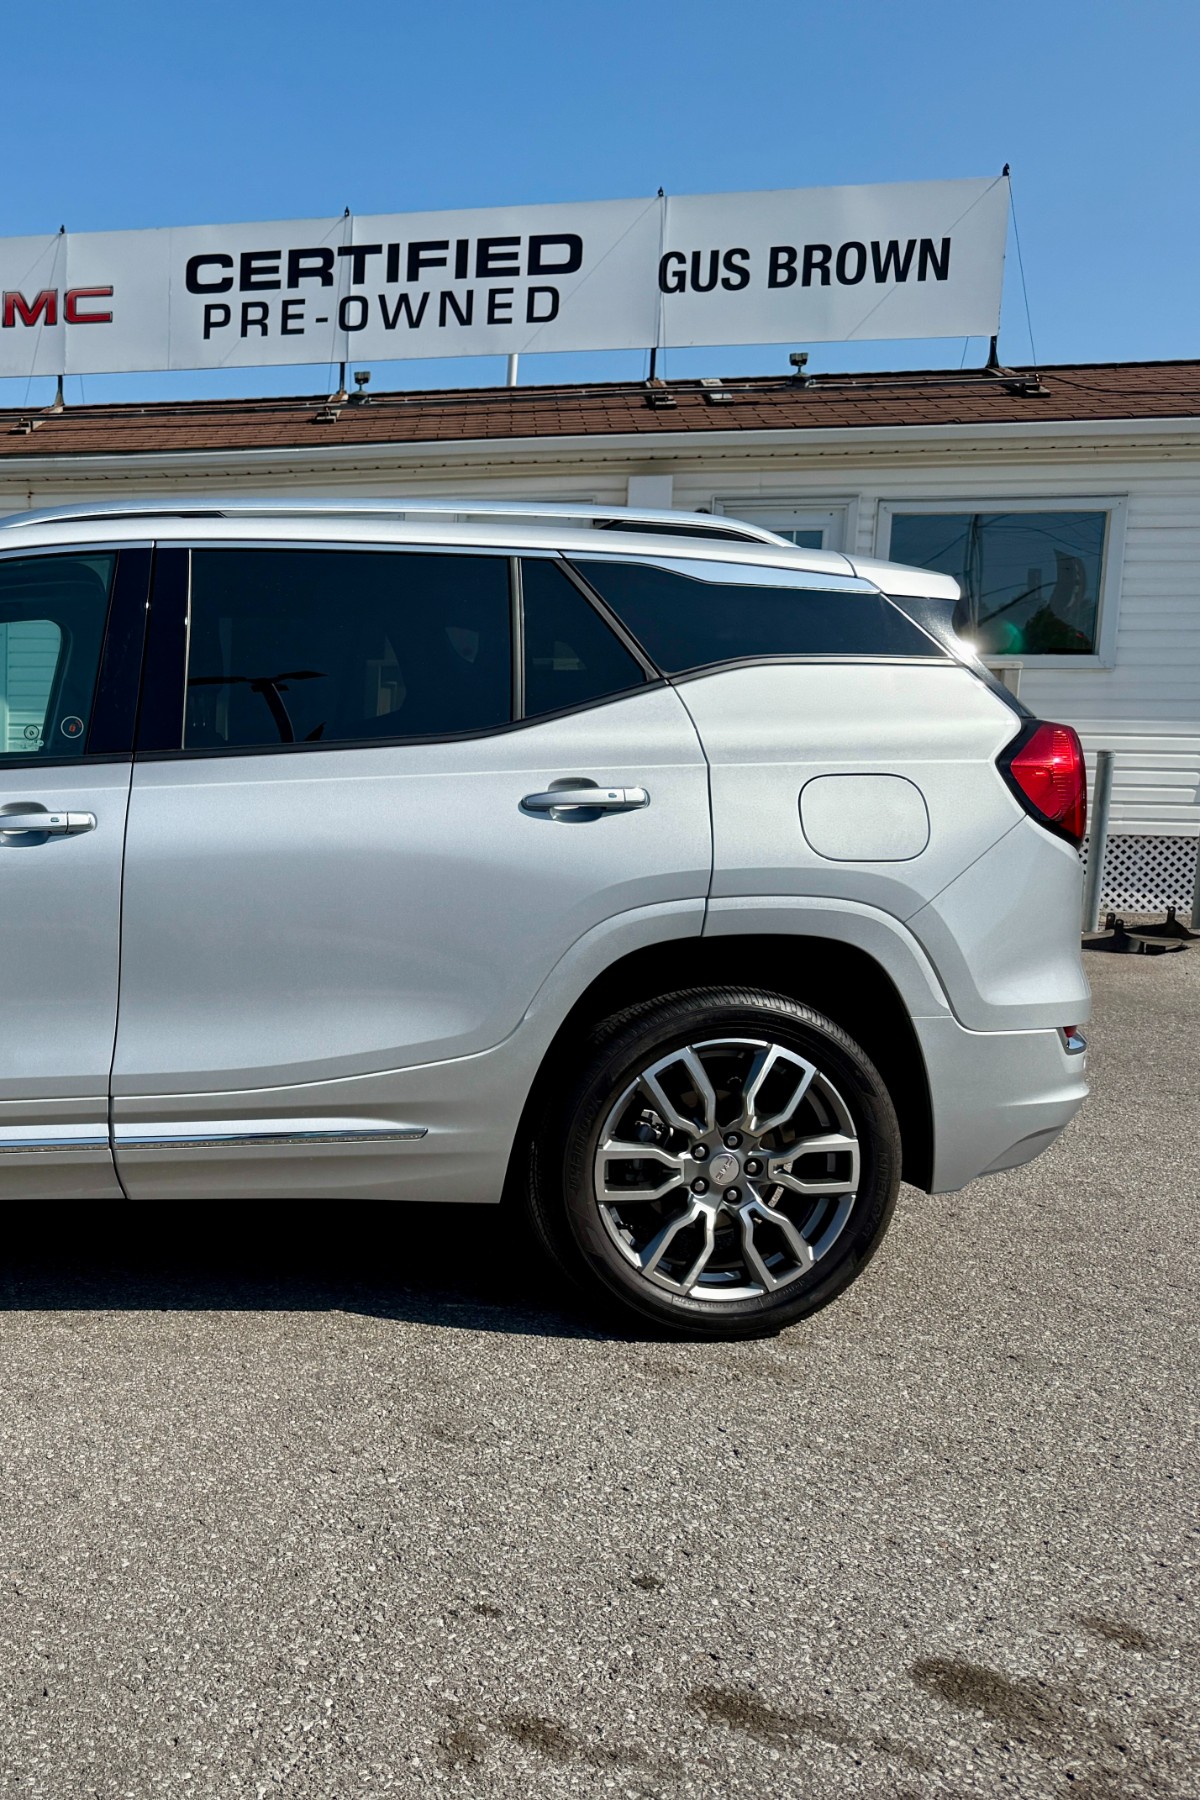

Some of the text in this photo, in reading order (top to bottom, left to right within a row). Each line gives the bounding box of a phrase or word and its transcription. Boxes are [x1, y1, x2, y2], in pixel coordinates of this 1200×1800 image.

[185, 233, 584, 295] CERTIFIED
[658, 237, 952, 294] GUS BROWN
[203, 285, 561, 340] PRE-OWNED
